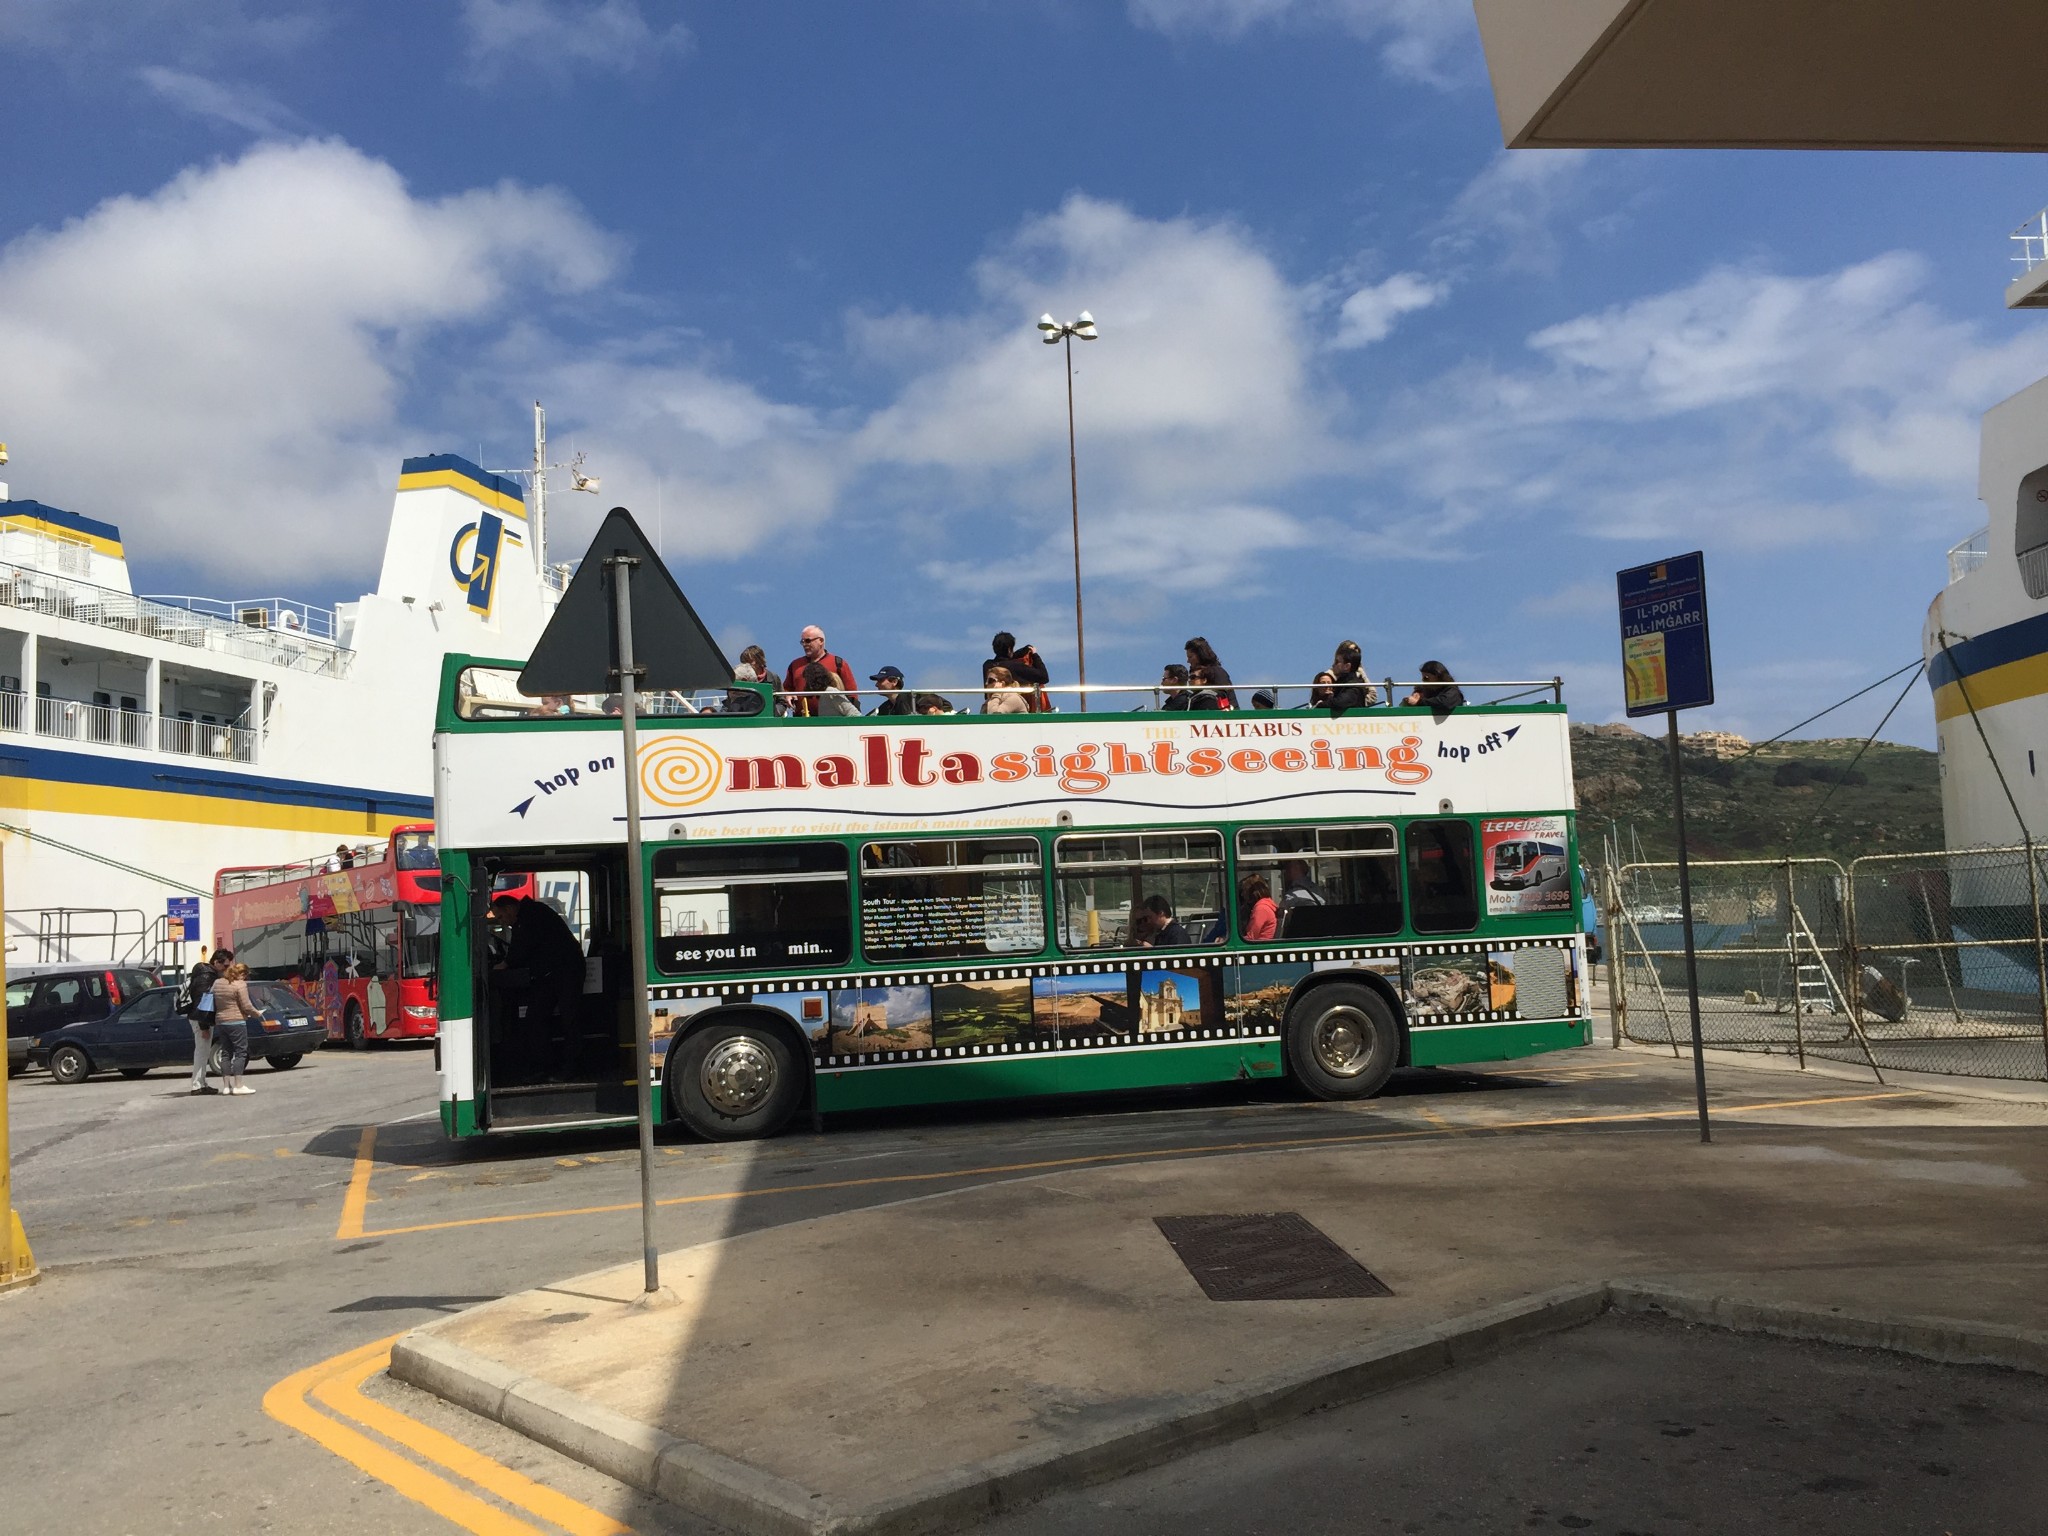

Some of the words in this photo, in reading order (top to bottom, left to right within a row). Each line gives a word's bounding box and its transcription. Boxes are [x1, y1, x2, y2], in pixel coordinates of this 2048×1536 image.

[1637, 598, 1684, 620] IL-PORT
[1625, 610, 1701, 637] TAL-IMĠARR
[1142, 726, 1180, 740] THE
[1189, 722, 1302, 739] MALTABUS
[1310, 720, 1422, 737] EXPERIENCE
[1437, 740, 1470, 763] hop
[1477, 731, 1503, 754] off
[725, 734, 984, 793] malta
[989, 736, 1432, 794] sightseeing
[534, 766, 580, 796] hop
[588, 755, 615, 774] on
[692, 826, 717, 838] the
[721, 825, 752, 837] best
[756, 825, 787, 836] way
[791, 825, 806, 834] to
[810, 822, 842, 834] visit
[845, 821, 870, 833] the
[874, 819, 928, 832] island's
[932, 818, 969, 829] main
[973, 816, 1052, 828] attractions
[1534, 831, 1565, 839] TRAVEL
[863, 898, 881, 906] South
[1489, 893, 1515, 904] Mob:
[1544, 890, 1570, 901] 3696
[675, 948, 702, 961] see
[705, 947, 736, 962] you
[739, 944, 757, 958] in
[788, 941, 833, 955] min...
